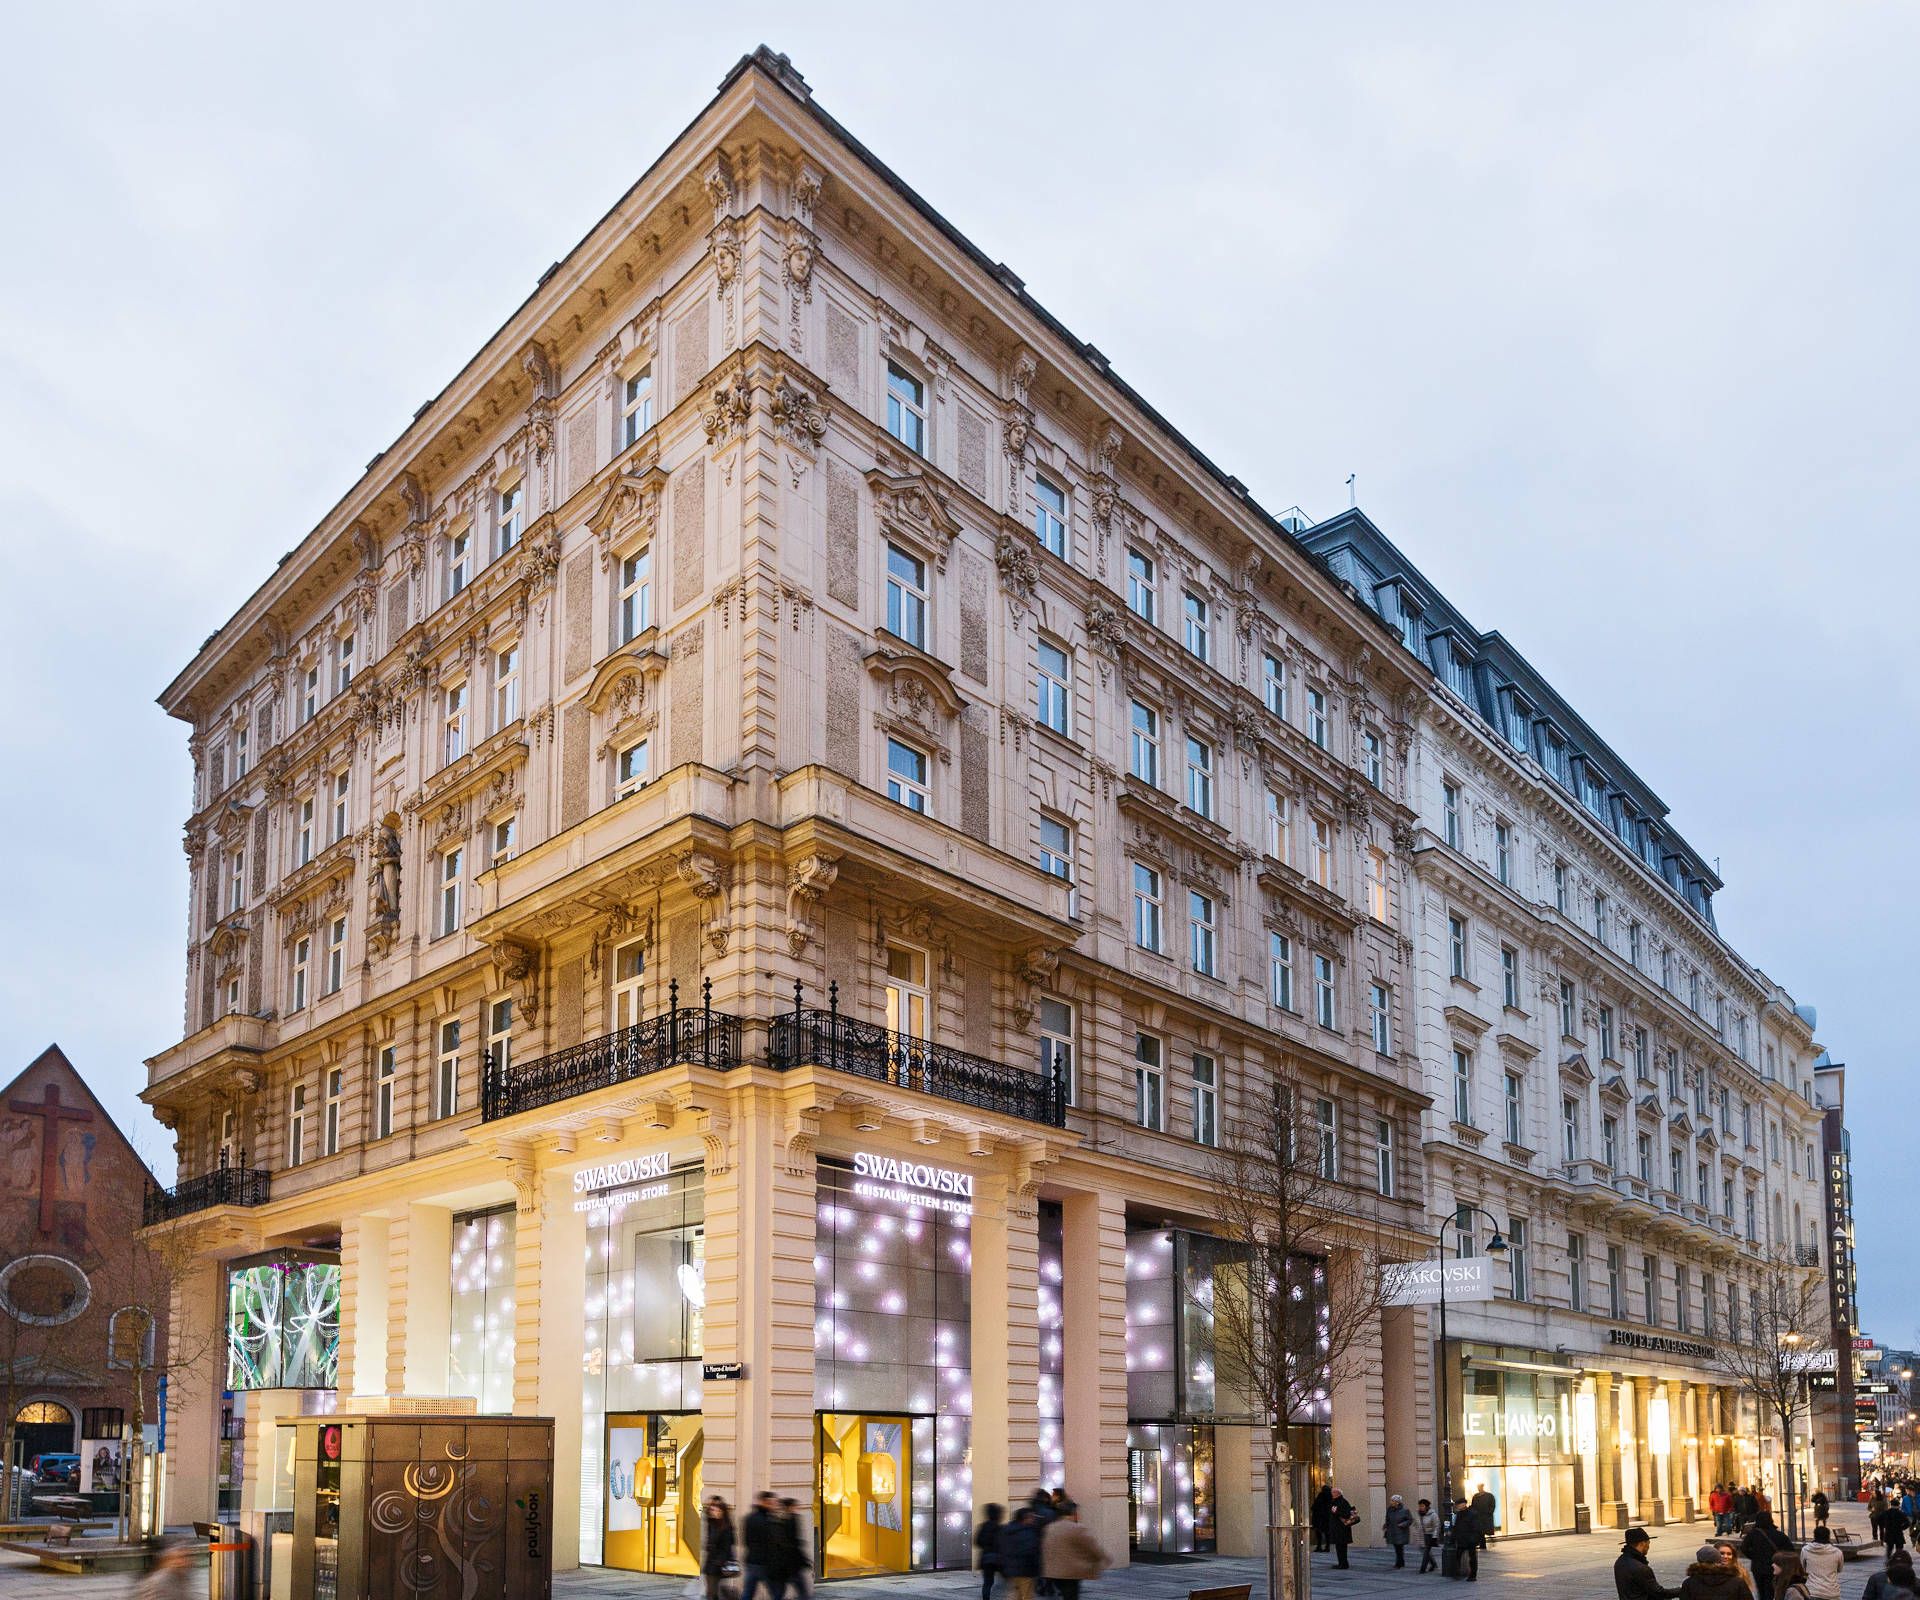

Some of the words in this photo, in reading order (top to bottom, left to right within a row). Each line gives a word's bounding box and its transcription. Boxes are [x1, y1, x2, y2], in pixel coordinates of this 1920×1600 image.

[574, 1152, 670, 1193] SWAROVSKI
[641, 1184, 669, 1200] STORE
[854, 1152, 974, 1196] SWAROVSKI
[1831, 1155, 1843, 1222] HOTEL
[942, 1201, 973, 1214] STORE
[1835, 1240, 1847, 1323] EUROPA
[1615, 1330, 1653, 1349] HOTEL
[525, 1493, 542, 1559] paulsbox
